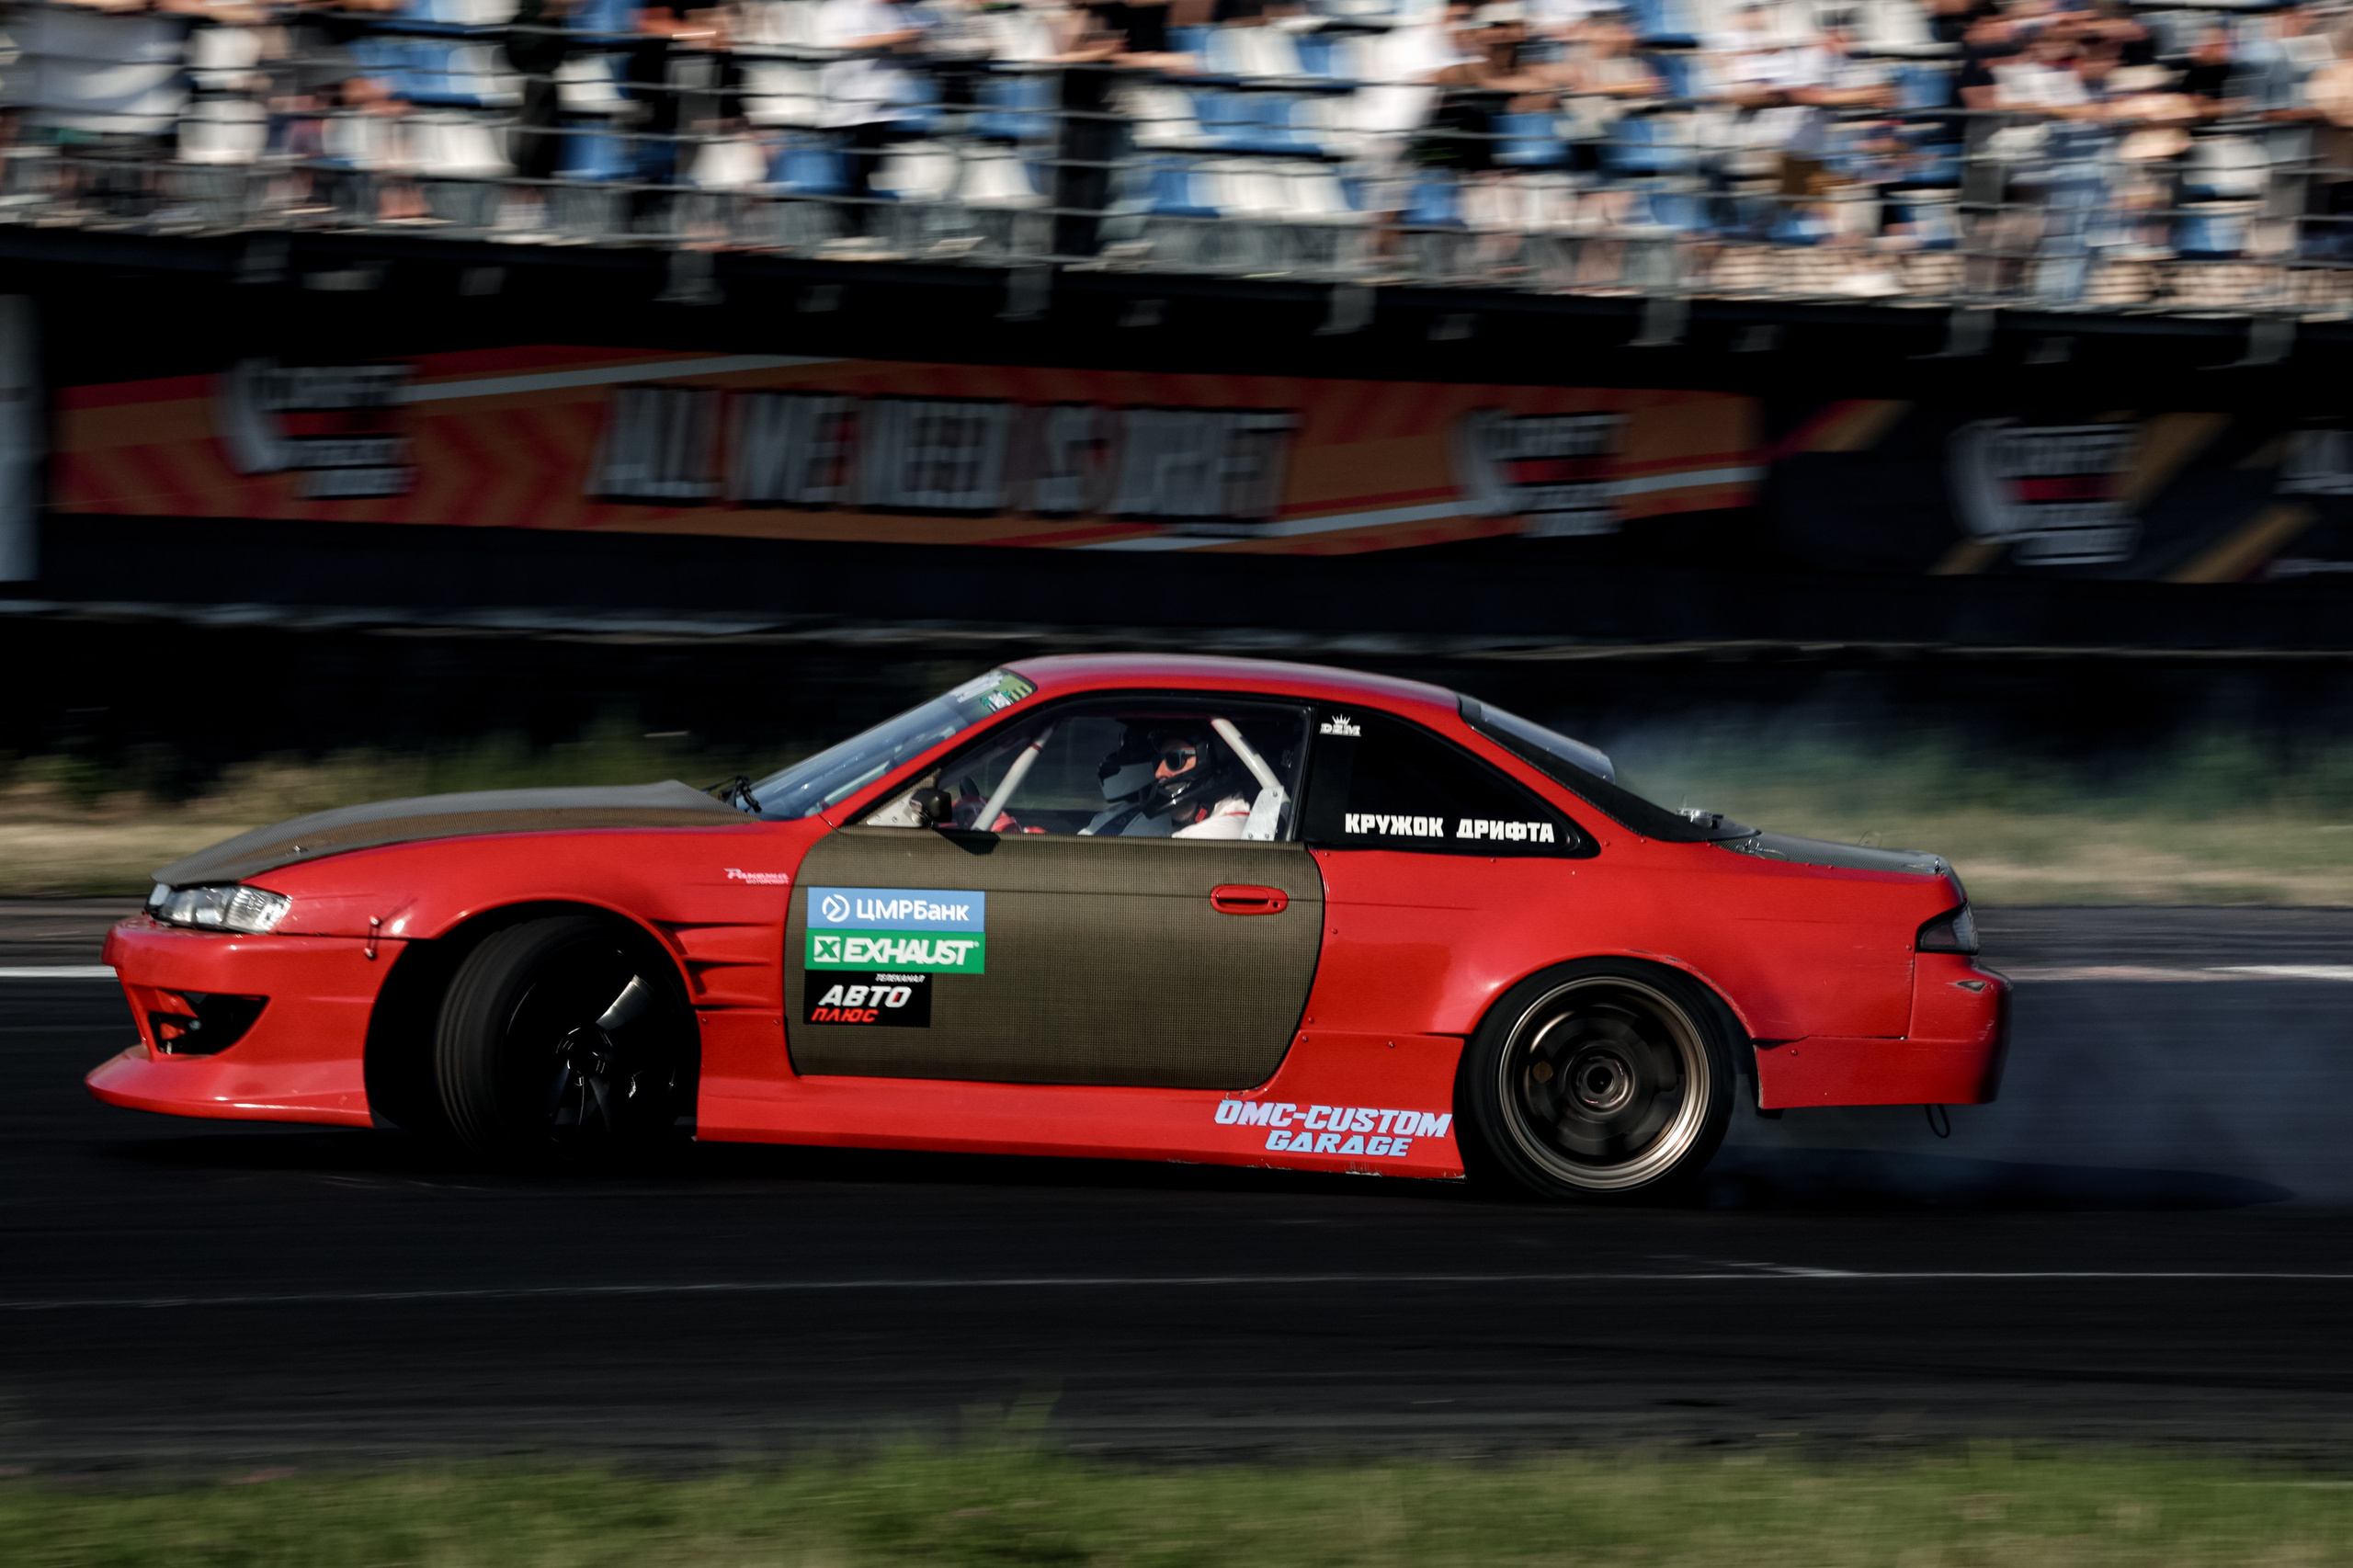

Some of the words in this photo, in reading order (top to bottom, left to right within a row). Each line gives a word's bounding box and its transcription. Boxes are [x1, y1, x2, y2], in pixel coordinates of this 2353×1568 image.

[1345, 813, 1444, 837] КРУЖОК
[1456, 818, 1555, 843] ДРИФТА
[857, 900, 970, 921] ЦМРБанк
[843, 937, 974, 965] EXHAUST
[818, 985, 912, 1007] АВТО
[811, 1007, 879, 1022] ПЛЮС
[1265, 1130, 1413, 1157] GARAGE
